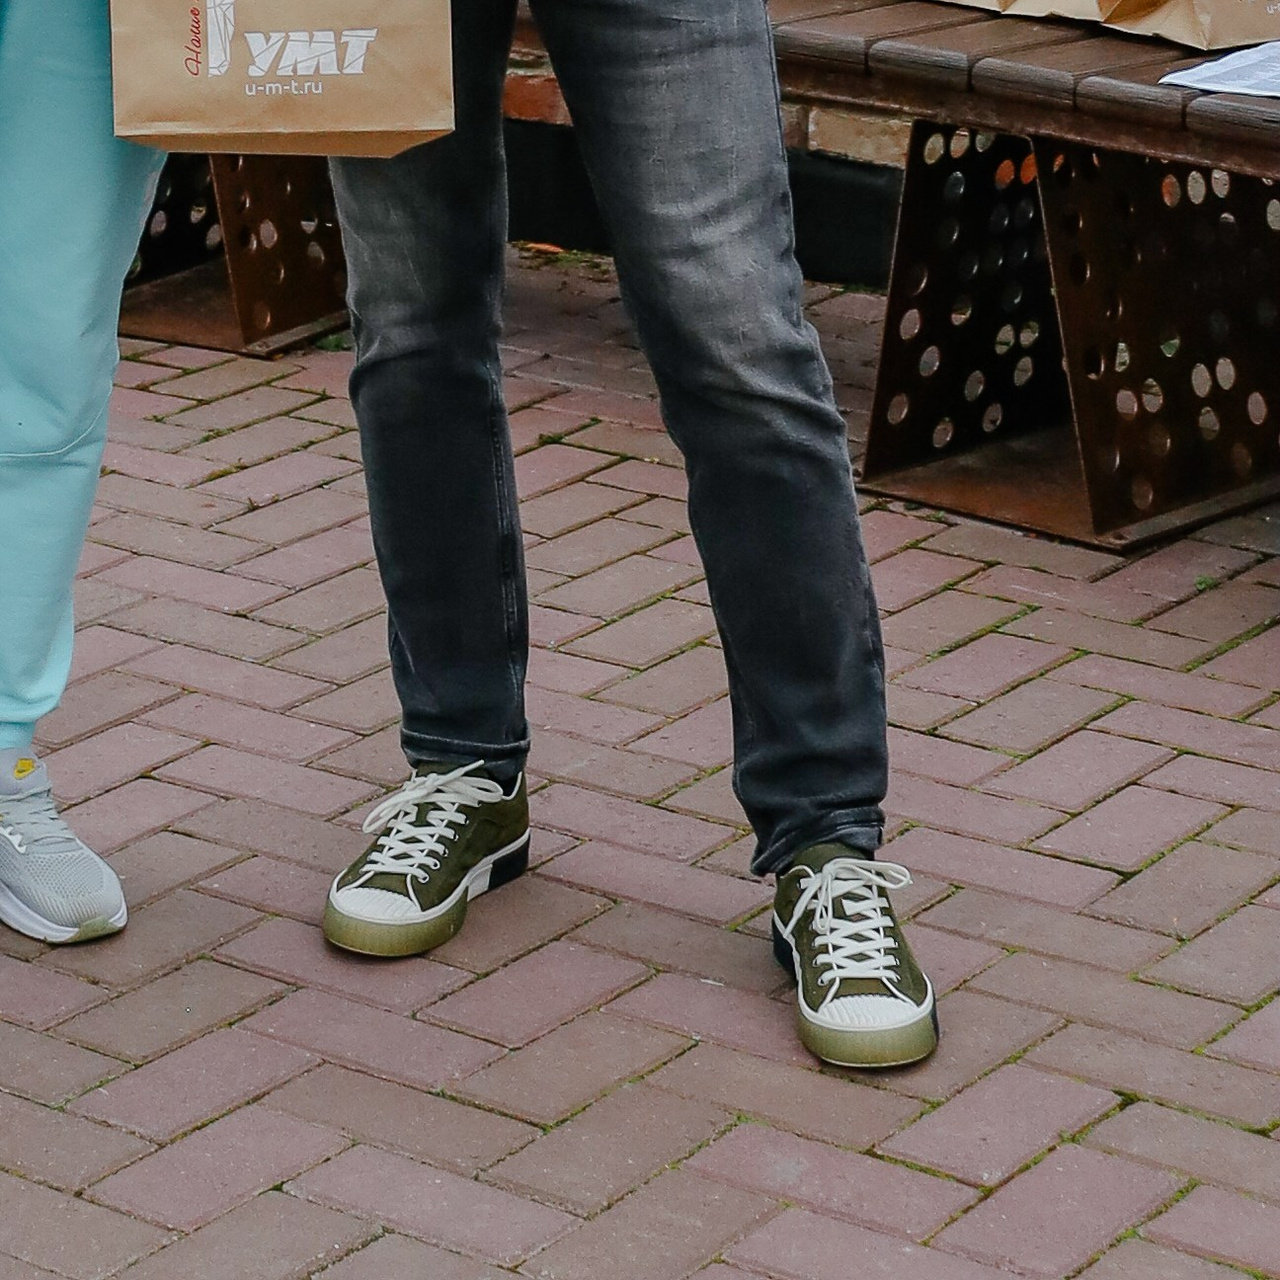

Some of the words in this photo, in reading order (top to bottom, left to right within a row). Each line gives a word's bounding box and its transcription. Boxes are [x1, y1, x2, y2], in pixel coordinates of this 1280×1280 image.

[184, 6, 202, 78] Наше
[243, 27, 378, 77] УМТ
[244, 79, 323, 96] u-m-t.ru
